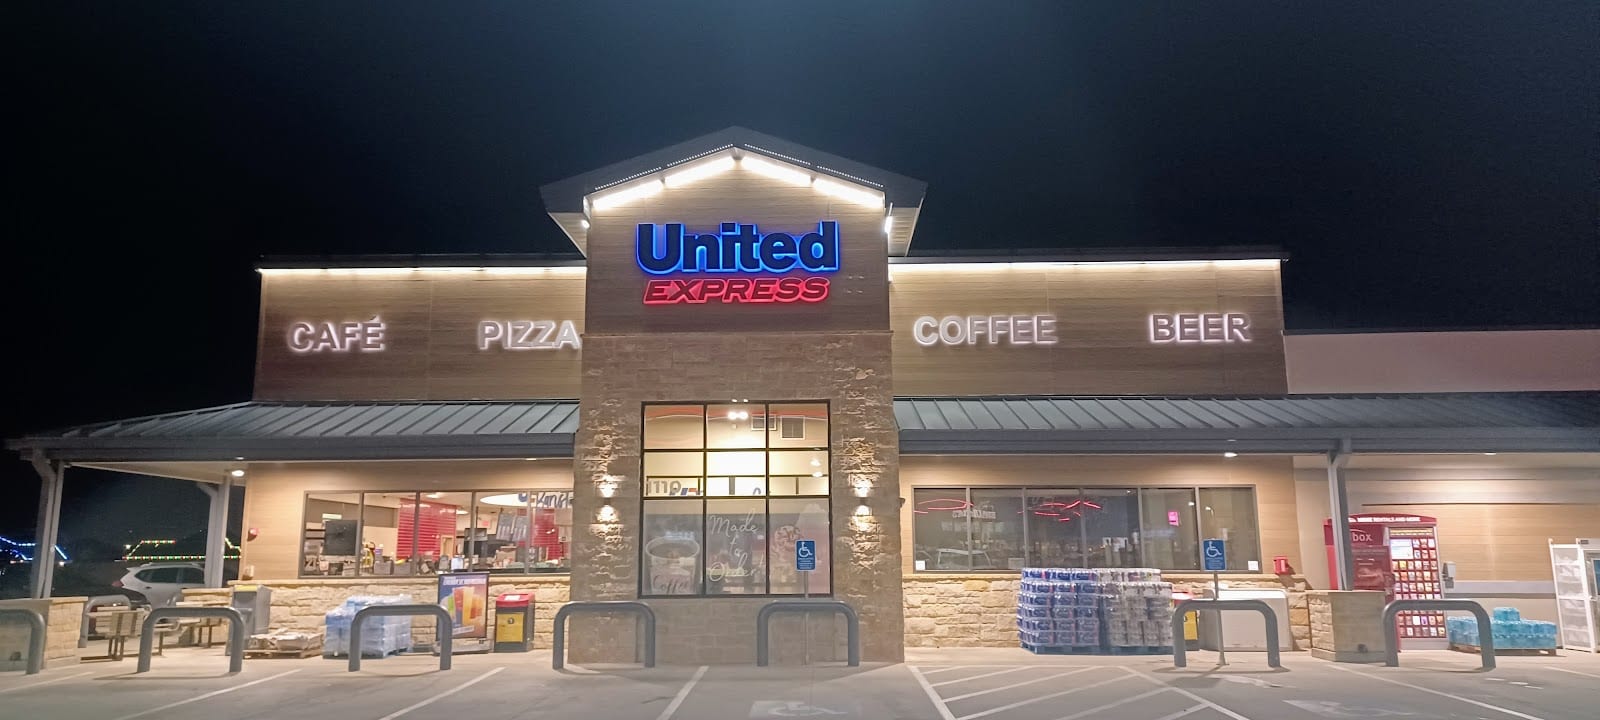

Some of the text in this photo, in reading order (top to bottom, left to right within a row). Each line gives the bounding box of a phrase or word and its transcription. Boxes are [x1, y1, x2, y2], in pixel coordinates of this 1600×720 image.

[636, 220, 840, 275] United
[643, 276, 831, 304] EXPRESS
[286, 315, 386, 353] CAFÉ
[478, 320, 581, 351] PIZZA
[913, 314, 1058, 345] COFFEE
[1149, 312, 1252, 343] BEER
[710, 508, 758, 537] Made
[1352, 532, 1373, 542] box
